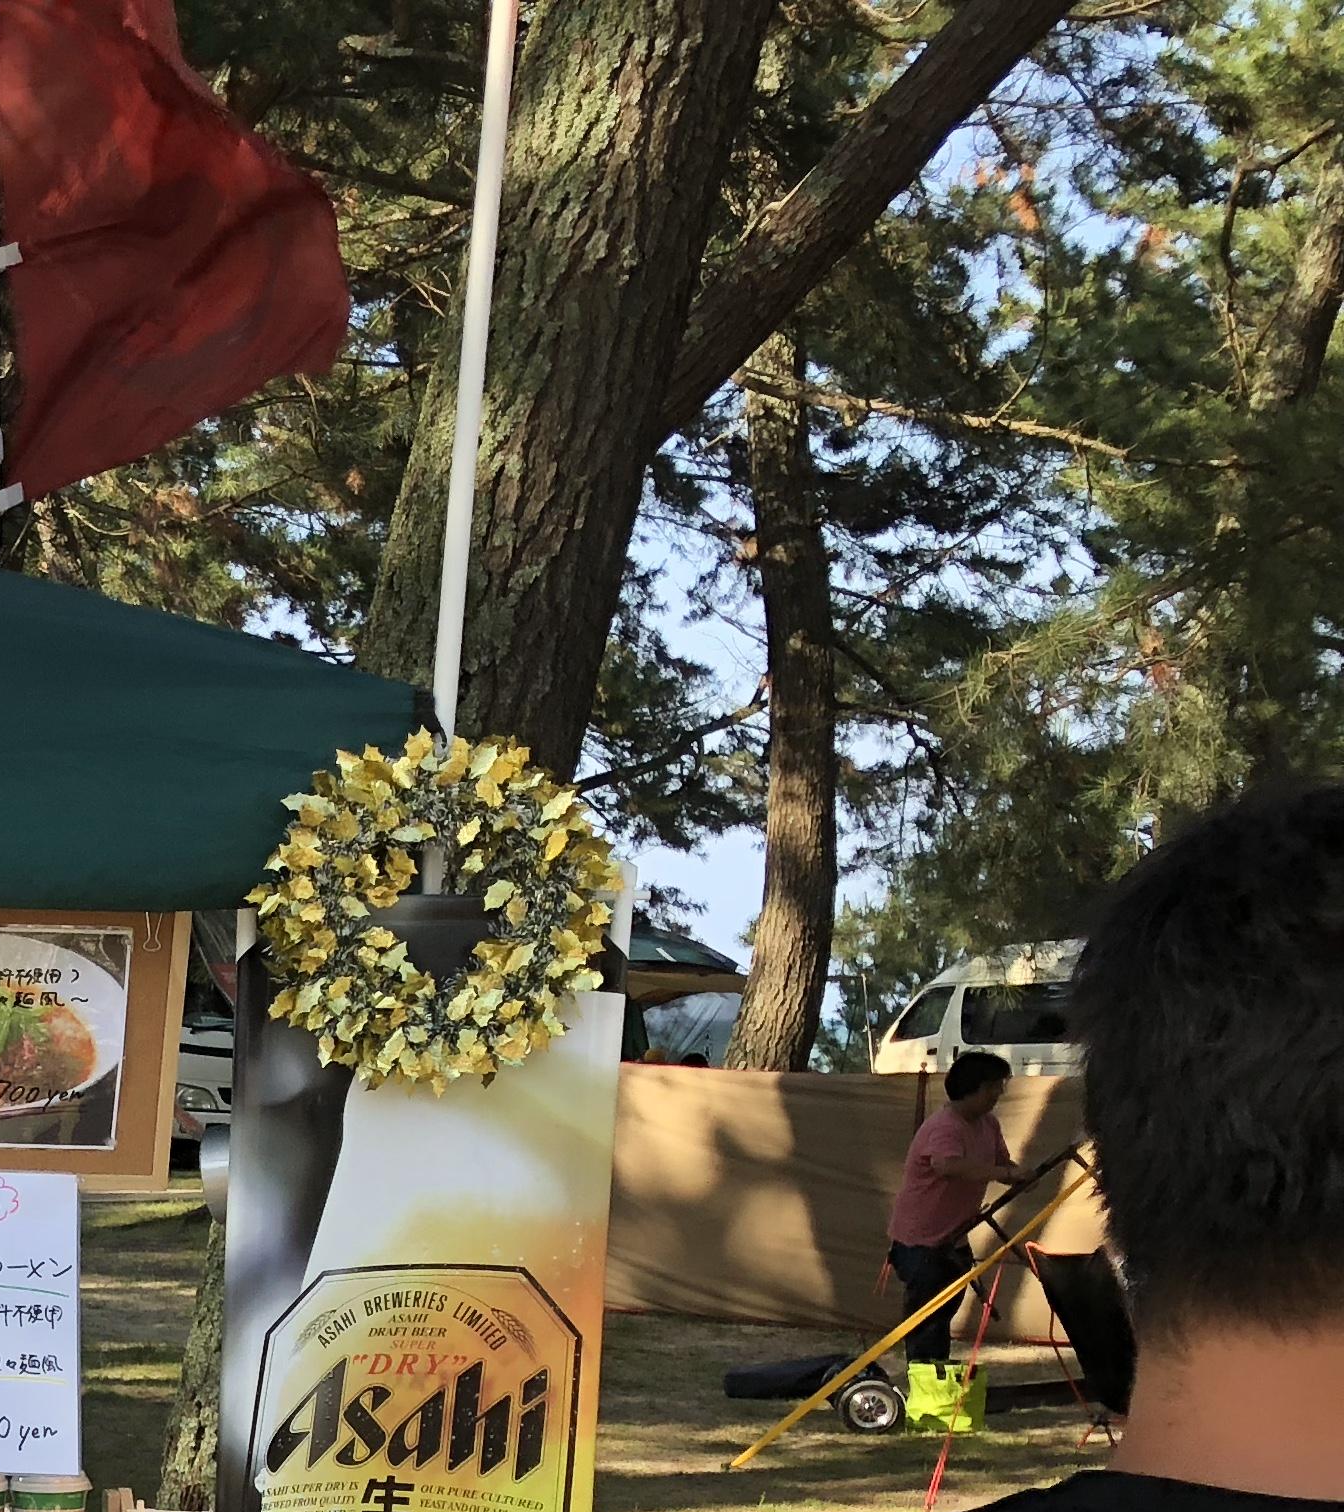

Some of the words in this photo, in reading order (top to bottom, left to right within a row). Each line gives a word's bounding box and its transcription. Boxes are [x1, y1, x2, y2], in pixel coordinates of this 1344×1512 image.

[45, 1087, 85, 1111] yen
[317, 1308, 357, 1348] ASAHI
[364, 1290, 448, 1317] BREWERIES
[452, 1301, 508, 1351] LIMITED
[388, 1313, 429, 1324] ASAHI
[368, 1327, 410, 1338] DRAFT
[411, 1327, 447, 1338] BEER
[390, 1339, 437, 1350] SUPER
[265, 1357, 551, 1483] Asahi
[18, 1423, 58, 1451] yen
[325, 1481, 347, 1492] DRY
[350, 1481, 360, 1490] IS
[419, 1499, 447, 1510] YEAST
[420, 1484, 446, 1495] OUR
[447, 1486, 479, 1499] PURE
[480, 1491, 544, 1511] CULTURED
